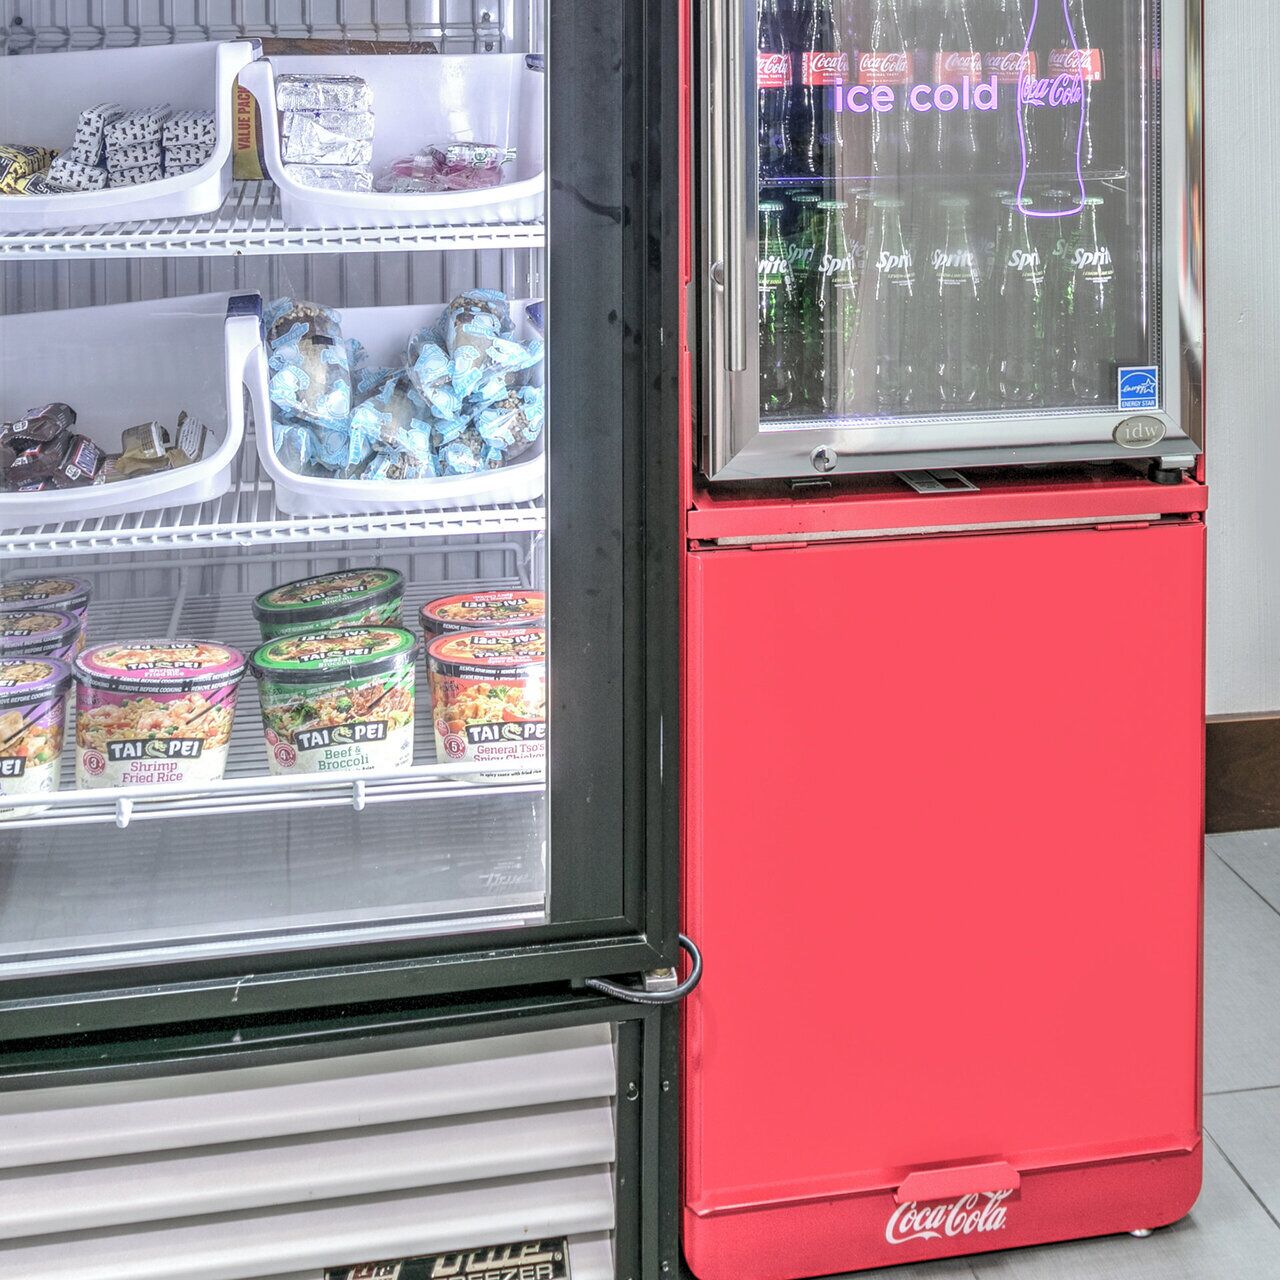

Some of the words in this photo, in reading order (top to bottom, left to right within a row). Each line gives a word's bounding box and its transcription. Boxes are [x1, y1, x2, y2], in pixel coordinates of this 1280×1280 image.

[859, 52, 907, 73] Coca-Cola
[835, 78, 895, 113] ice
[909, 75, 998, 112] cold
[1021, 72, 1083, 108] Coca-Cola
[237, 121, 251, 151] VALUE
[1122, 400, 1141, 408] ENERGY
[1125, 423, 1158, 439] idw
[299, 732, 330, 748] TAI
[355, 723, 384, 739] PEI
[469, 725, 500, 741] TAI
[110, 742, 143, 758] TAI
[169, 740, 200, 756] PEI
[325, 748, 352, 759] Beef
[477, 744, 518, 755] General
[130, 761, 178, 775] Shrimp
[318, 755, 369, 771] Broccoli
[122, 772, 154, 784] Fried
[156, 771, 183, 783] Rice
[885, 1188, 1013, 1245] Coca-Cola
